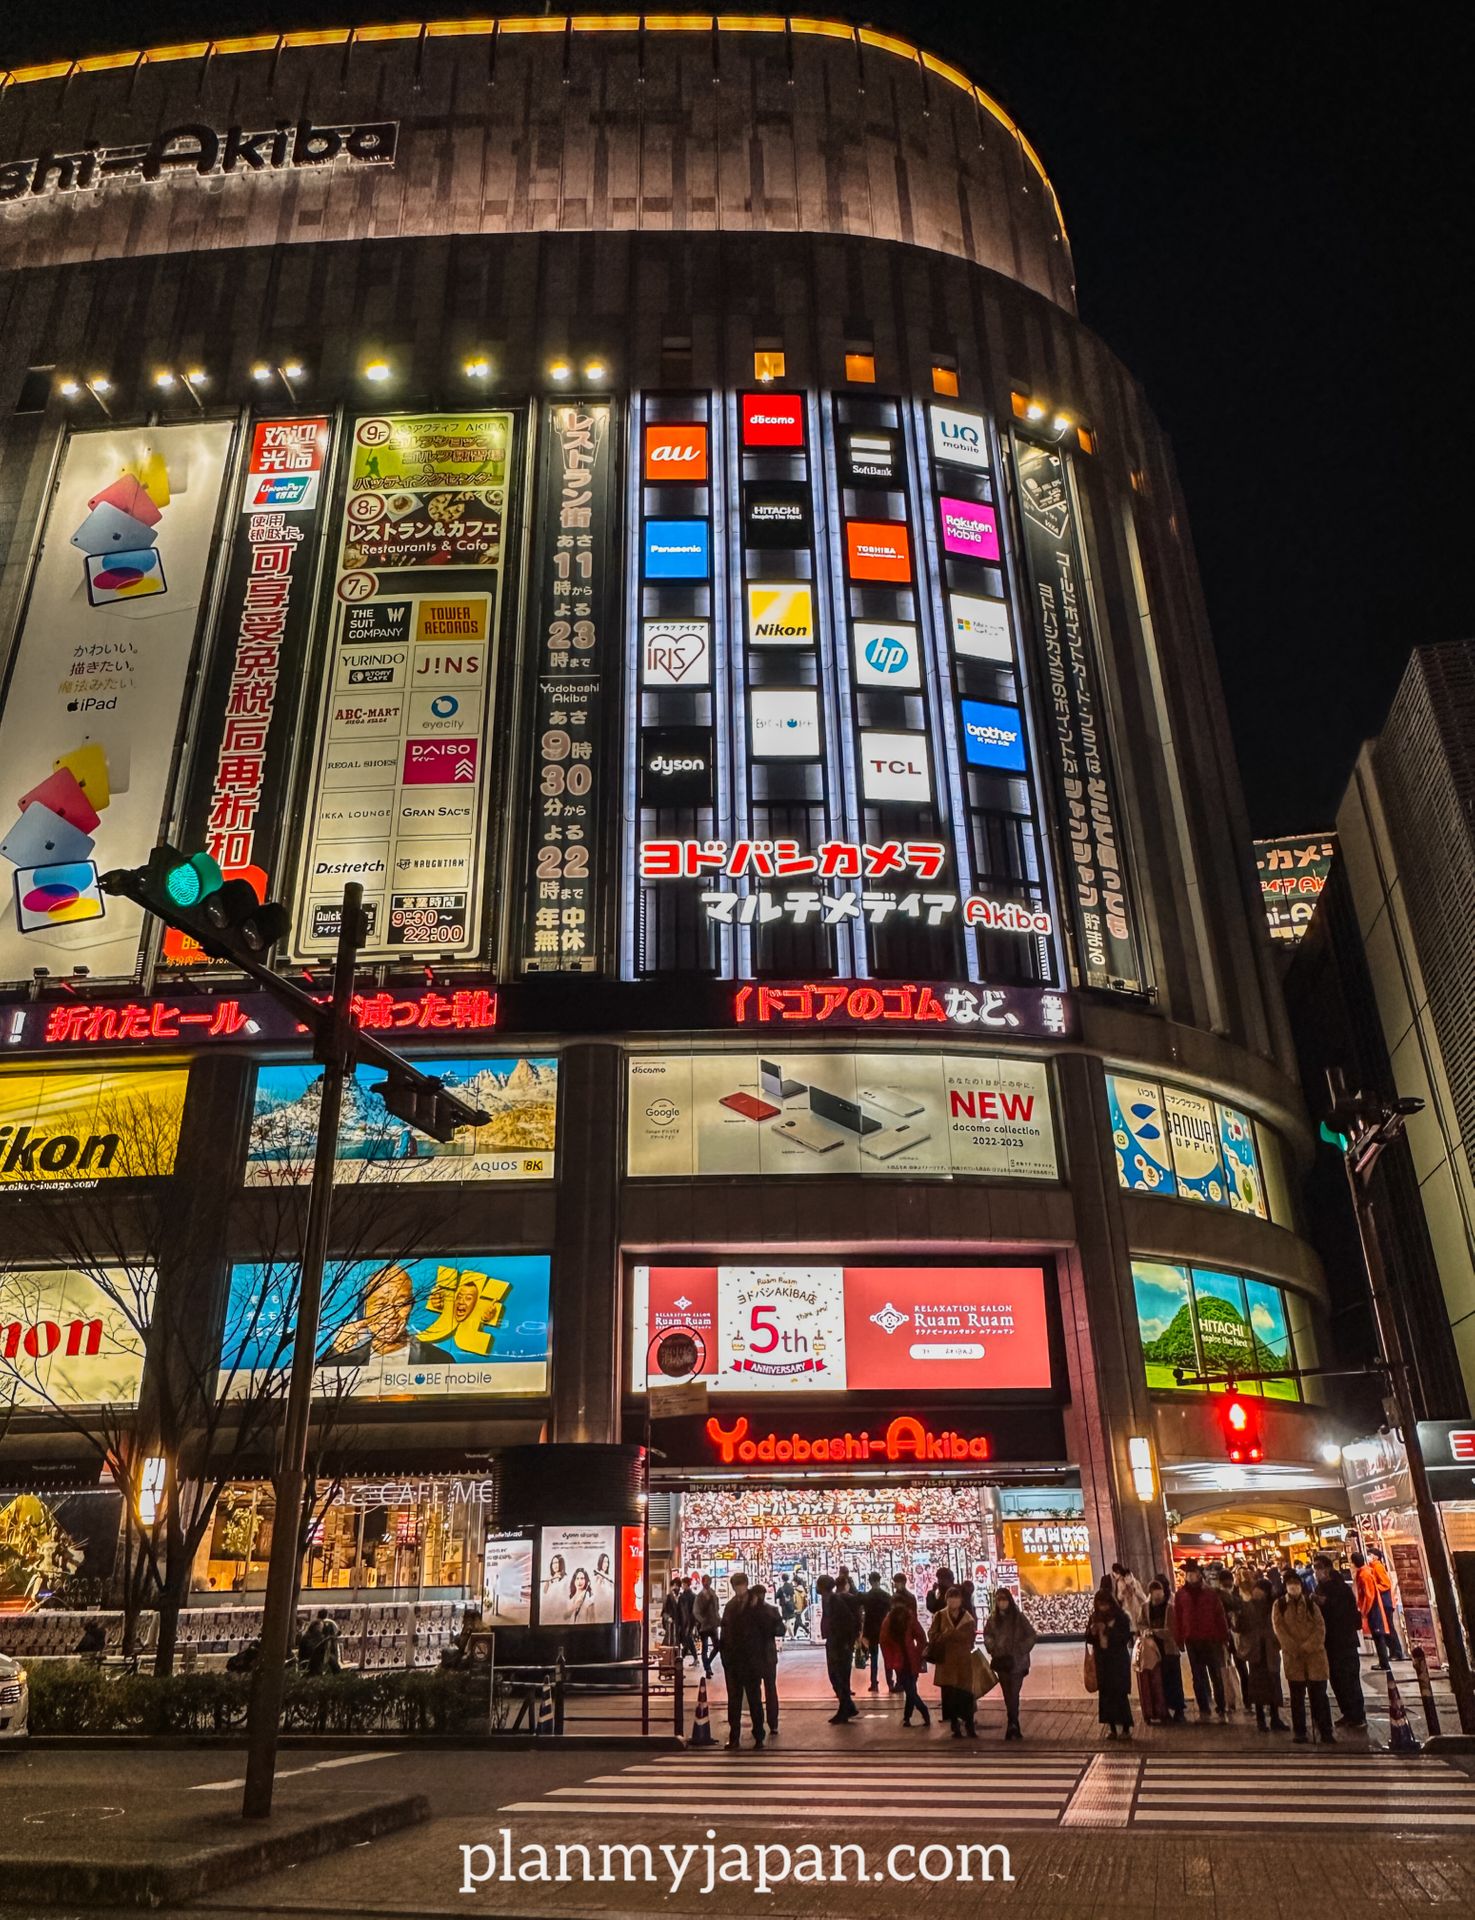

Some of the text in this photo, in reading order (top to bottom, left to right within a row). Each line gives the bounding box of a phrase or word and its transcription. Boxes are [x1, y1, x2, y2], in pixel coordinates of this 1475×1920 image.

[750, 415, 795, 425] docomo
[263, 424, 317, 447] 欢迎
[366, 426, 386, 440] 9F
[940, 421, 979, 447] UQ
[651, 445, 701, 462] au
[943, 440, 980, 453] mobile
[260, 450, 313, 470] 光临
[852, 465, 893, 477] SoftBank
[356, 500, 378, 516] 8F
[754, 506, 800, 515] HITACHI
[251, 513, 285, 528] 使用
[945, 514, 993, 533] Rakuten
[556, 535, 594, 548] あさ
[947, 527, 982, 543] Mobile
[361, 538, 489, 555] Restaurants & Cafe
[651, 544, 702, 553] Panasonic
[857, 545, 896, 554] TOSHIBA
[553, 551, 592, 579] 11
[348, 579, 368, 595] 7F
[553, 580, 593, 597] 時から
[352, 609, 374, 618] THE
[430, 607, 470, 619] TOWER
[554, 603, 591, 616] よる
[350, 619, 375, 629] SUIT
[424, 621, 478, 635] RECORDS
[755, 624, 807, 636] Nikon
[348, 627, 403, 639] COMPANY
[547, 620, 596, 649] 23
[74, 642, 138, 656] かわいい。
[868, 637, 907, 673] hp
[342, 653, 405, 666] YURINDO
[550, 652, 591, 668] 時まで
[648, 648, 686, 670] IRIS
[69, 660, 136, 676] 描きたい。
[540, 682, 600, 694] Yodobashi
[80, 698, 117, 712] iPad
[552, 693, 588, 703] Akiba
[335, 708, 400, 720] ABC-MART
[549, 710, 588, 725] あさ
[422, 719, 464, 730] eyecity
[967, 723, 1018, 743] brother
[412, 744, 470, 755] DAISO
[327, 760, 361, 769] REGAL
[650, 756, 705, 775] dyson
[870, 760, 922, 775] TCL
[540, 763, 593, 796] 30
[348, 810, 391, 819] LOUNGE
[543, 798, 587, 817] 分から
[544, 824, 585, 840] よる
[316, 860, 385, 874] Dr.stretch
[536, 845, 590, 879] 22
[639, 839, 946, 880] ヨドバシカメラ
[539, 881, 584, 900] 時まで
[701, 891, 1052, 935] マルチメディア Akiba
[403, 925, 464, 943] 22:00
[632, 1065, 666, 1074] docomo
[646, 1108, 680, 1118] Google
[950, 1090, 1035, 1122] NEW
[953, 1123, 1041, 1136] docomo collection
[973, 1136, 1024, 1147] 2022-2023
[472, 1159, 543, 1172] AQUOS 8K
[757, 1276, 798, 1286] Ruam Ruam
[737, 1286, 818, 1305] ヨドバシAKIBA店
[655, 1317, 712, 1326] Ruam Ruam
[914, 1313, 1015, 1328] Ruam Ruam
[1198, 1318, 1245, 1338] HITACHI
[1201, 1334, 1222, 1346] nspire
[750, 1362, 806, 1375] ANNIVERSARY
[444, 1371, 492, 1386] mobile
[707, 1416, 988, 1463] Yodobashi-Akiba
[380, 1481, 448, 1506] CAFE
